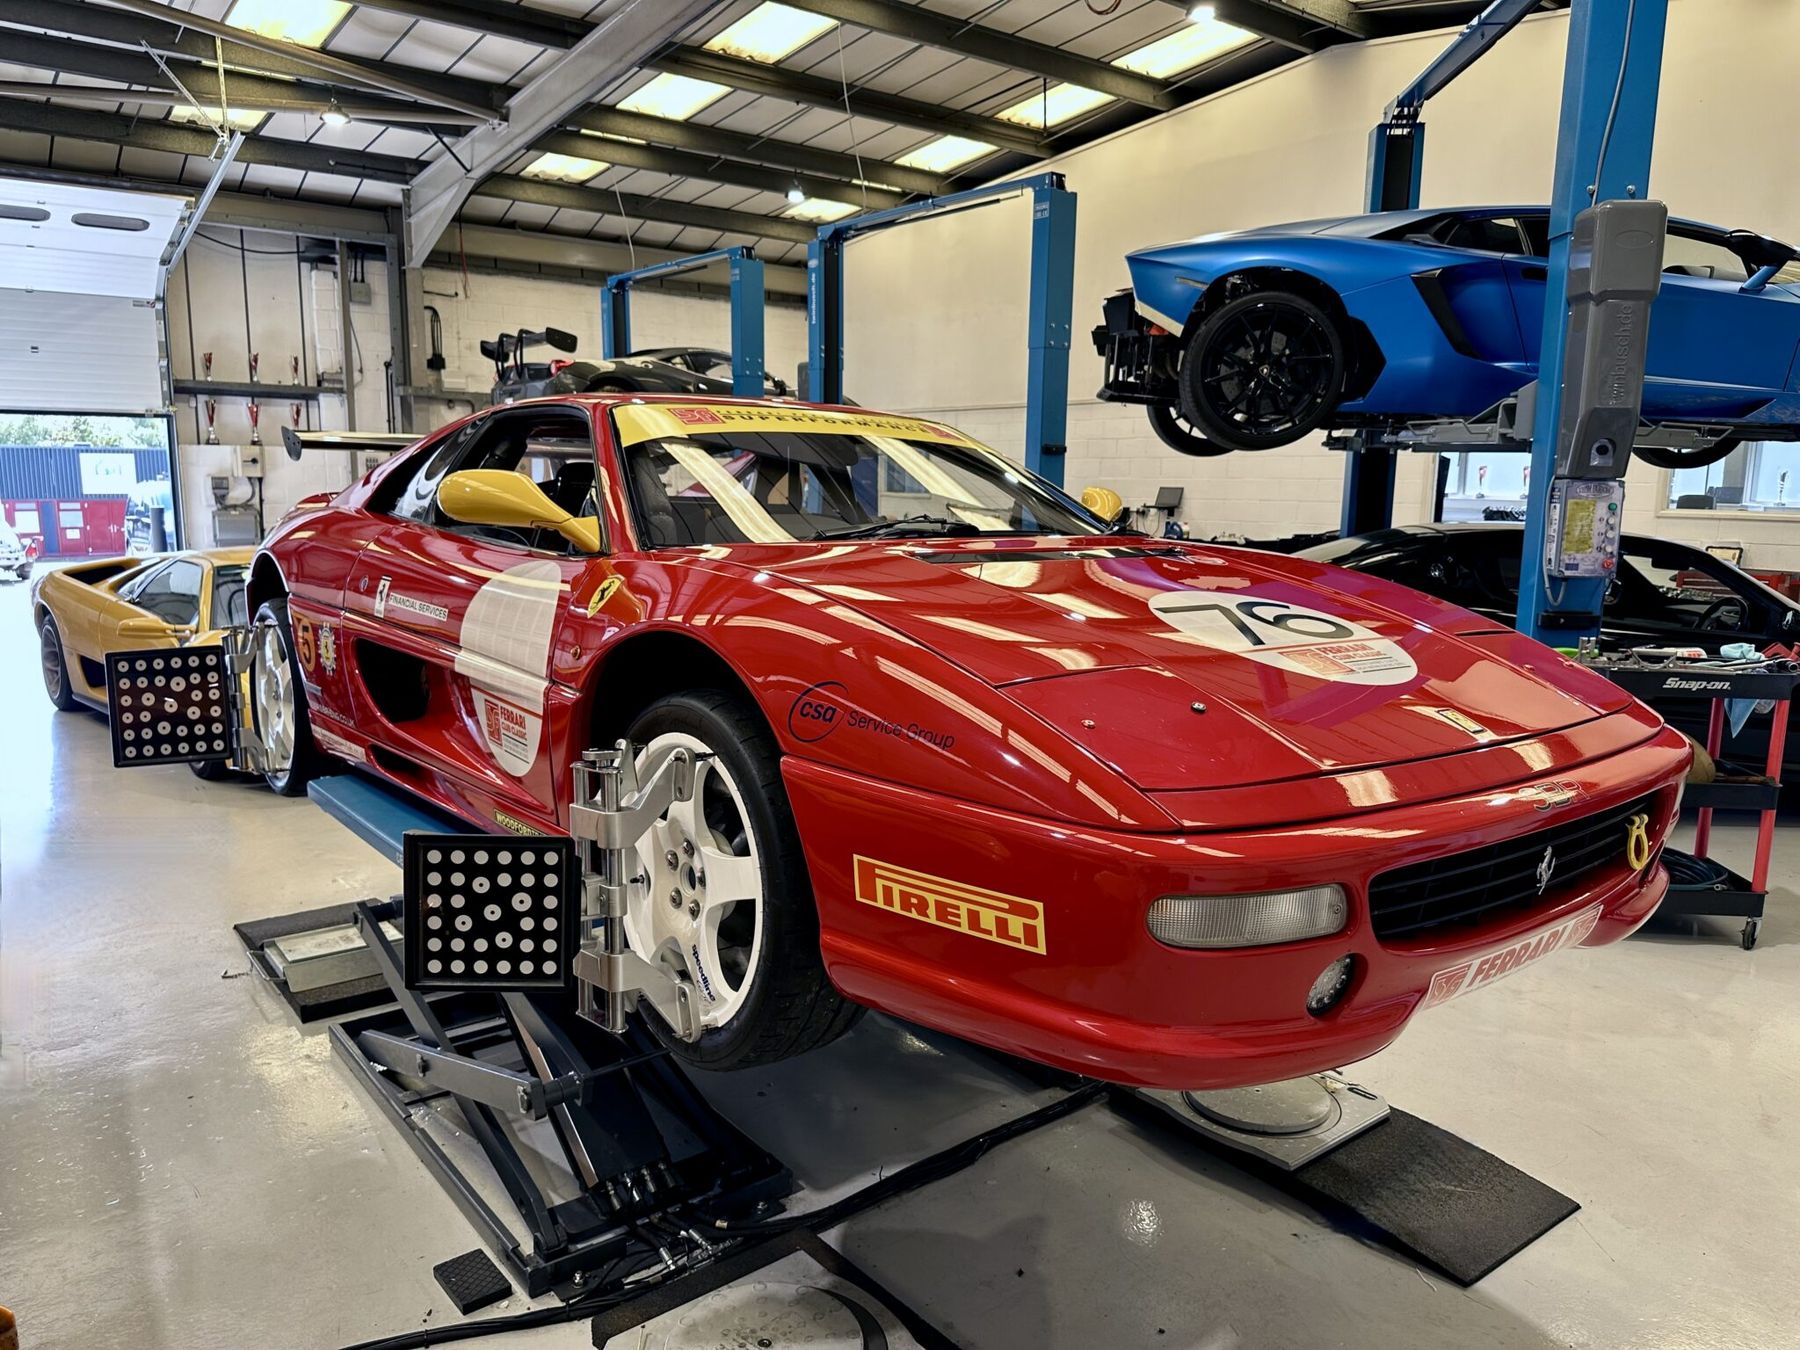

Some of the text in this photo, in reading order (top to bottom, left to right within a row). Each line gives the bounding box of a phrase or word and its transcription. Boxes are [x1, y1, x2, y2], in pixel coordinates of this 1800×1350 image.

[389, 593, 418, 612] FINANCIAL
[418, 601, 447, 619] SERVICES
[1153, 601, 1354, 646] 76
[1314, 643, 1375, 655] FERRARI
[500, 705, 527, 730] FERRARI
[800, 701, 837, 723] csa
[847, 710, 955, 750] Service Group
[857, 858, 1040, 950] PIRELLI
[691, 944, 716, 1002] speedline
[1466, 925, 1568, 988] FERRARI
